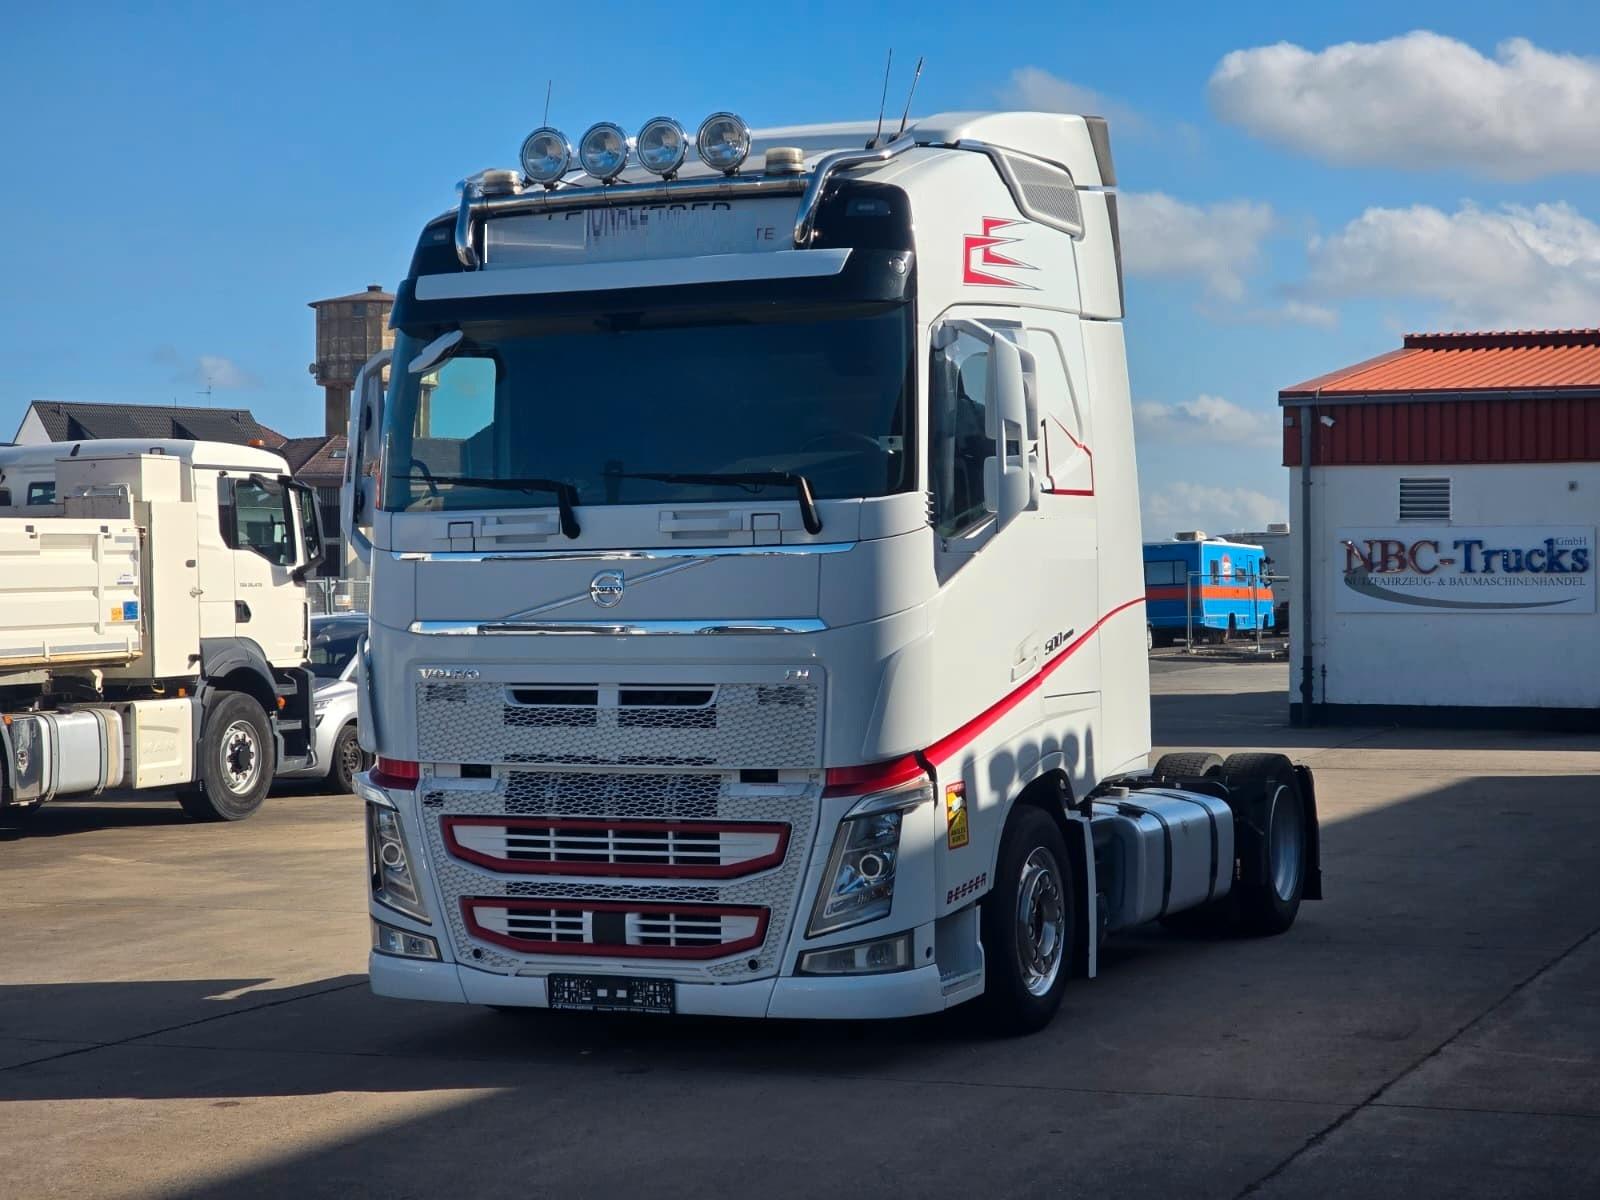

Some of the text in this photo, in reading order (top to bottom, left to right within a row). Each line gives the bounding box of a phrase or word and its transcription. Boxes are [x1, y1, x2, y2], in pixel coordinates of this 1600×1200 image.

[1555, 537, 1587, 546] GmbH
[1340, 537, 1590, 574] NBC-Trucks
[1438, 577, 1447, 586] &
[1449, 576, 1586, 586] BAUMASCHINENHANDEL
[1045, 632, 1063, 656] 500
[417, 668, 480, 680] VOLVO
